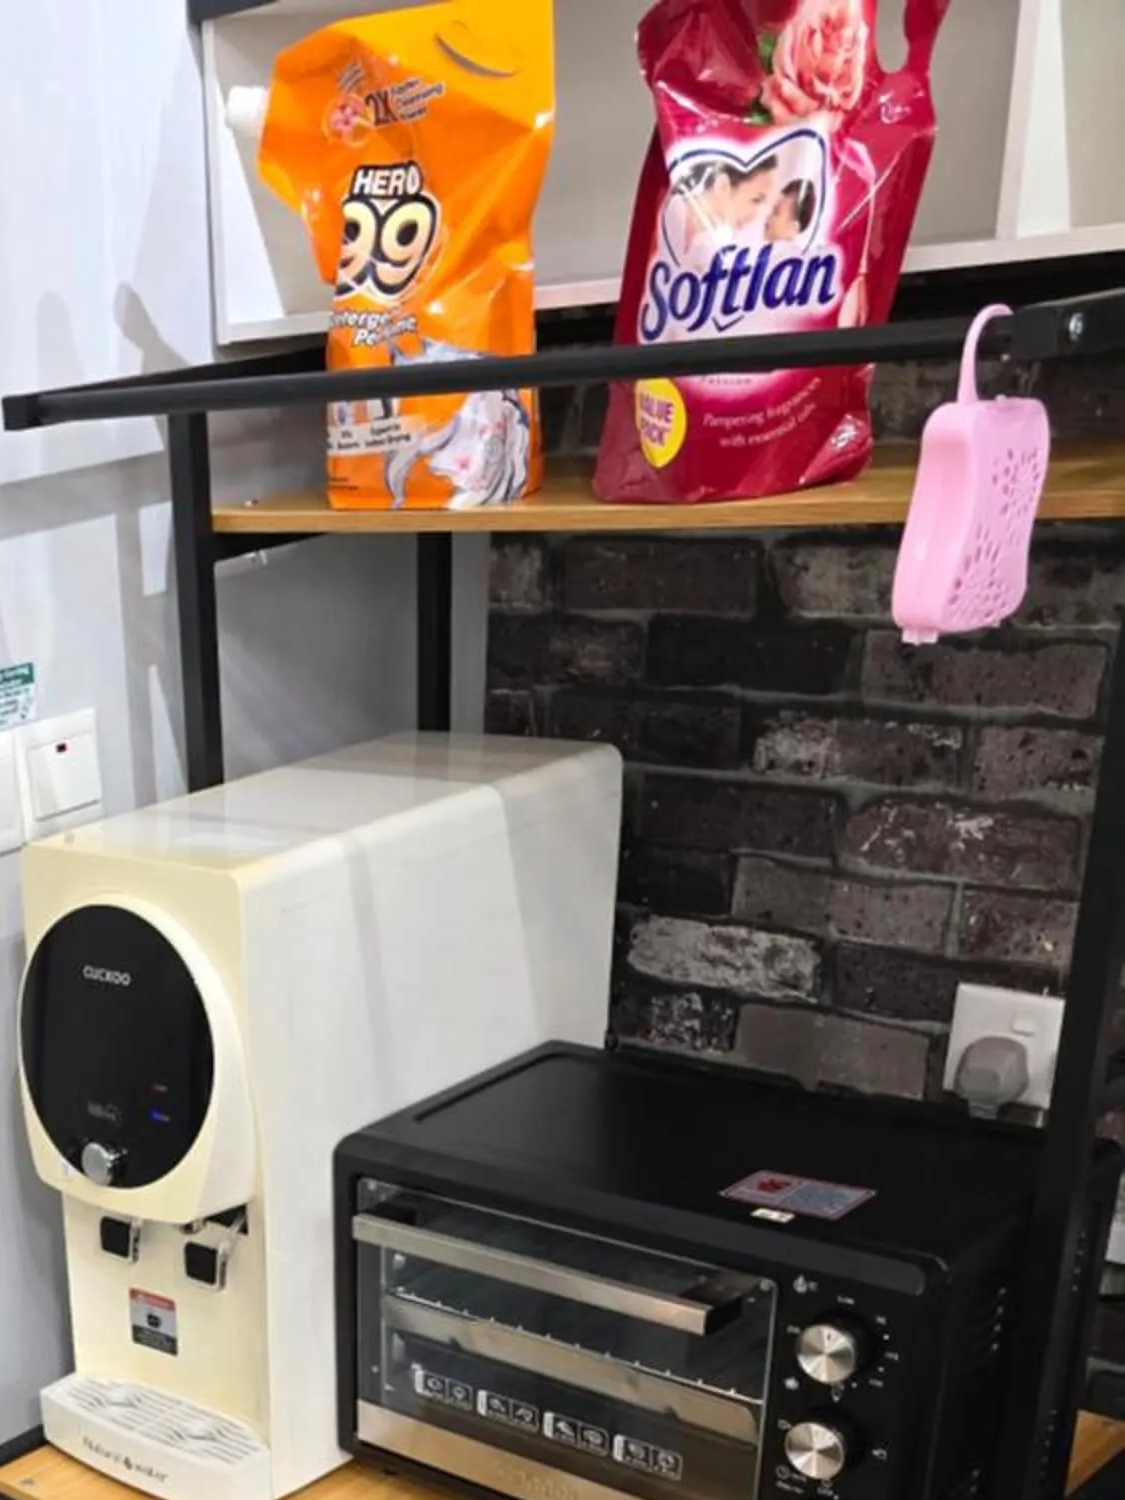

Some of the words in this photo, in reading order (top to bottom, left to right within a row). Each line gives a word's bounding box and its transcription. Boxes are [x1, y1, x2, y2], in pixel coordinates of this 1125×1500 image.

[353, 164, 422, 197] HERO
[335, 200, 438, 299] 99
[638, 244, 837, 343] Softlan
[82, 963, 132, 987] CUCKOO
